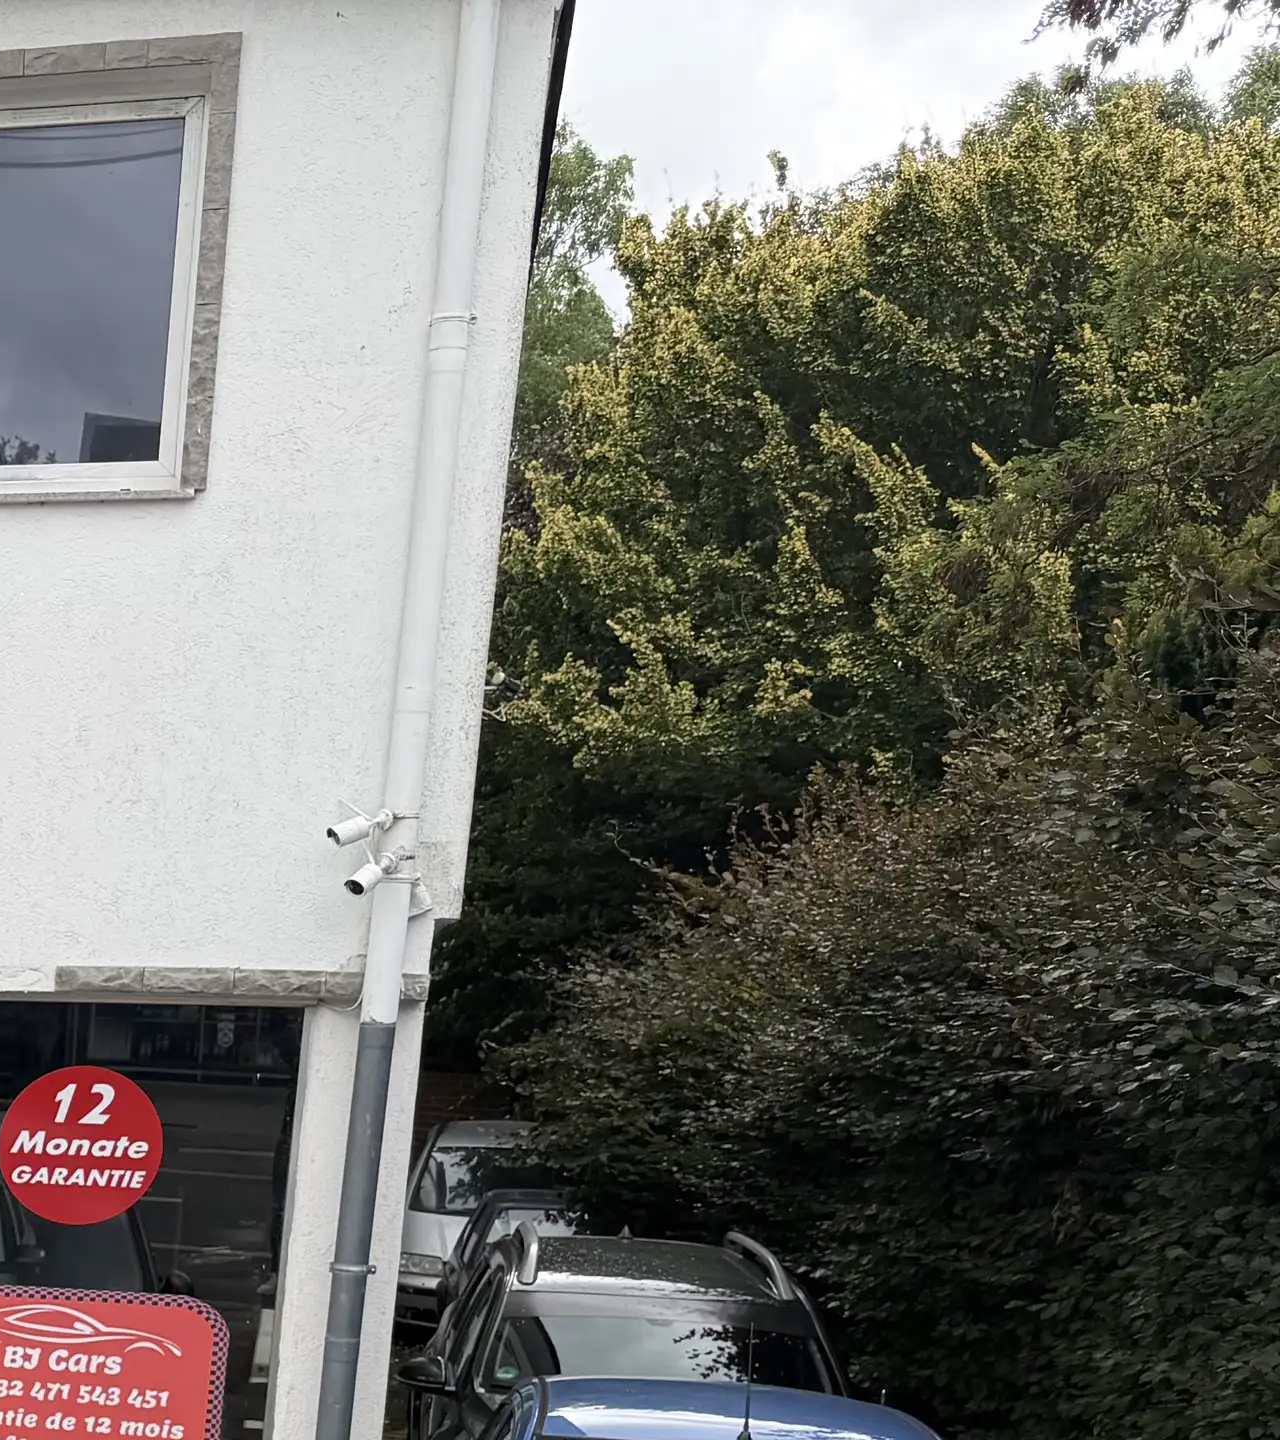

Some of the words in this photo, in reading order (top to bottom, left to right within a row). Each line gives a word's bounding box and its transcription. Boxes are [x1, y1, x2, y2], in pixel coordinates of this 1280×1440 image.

[54, 1083, 115, 1125] 12
[10, 1130, 149, 1159] Monate
[11, 1165, 147, 1189] GARANTIE
[3, 1345, 41, 1369] BJ
[48, 1349, 123, 1375] Cars
[30, 1382, 70, 1400] 471
[76, 1387, 121, 1406] 543
[127, 1390, 170, 1409] 451
[45, 1412, 76, 1432] de
[84, 1416, 112, 1434] 12
[120, 1419, 185, 1440] mois
